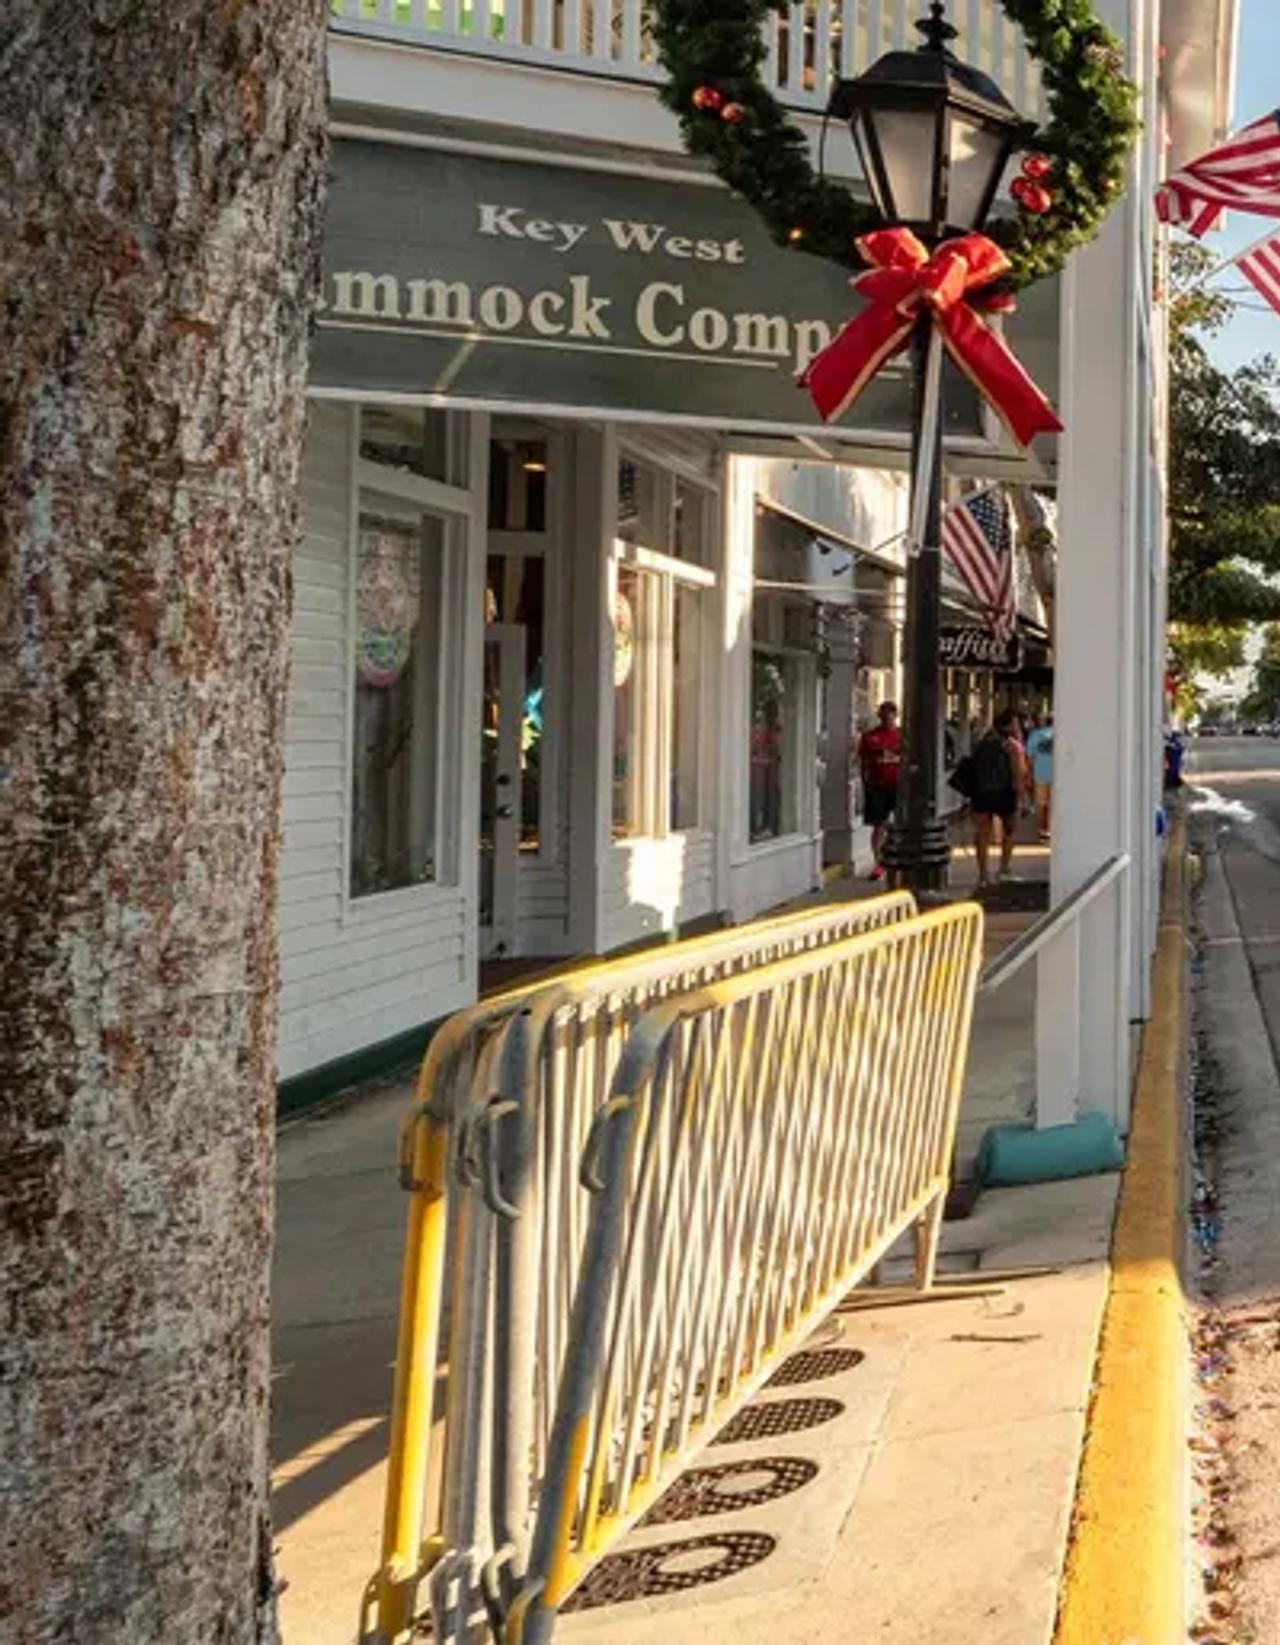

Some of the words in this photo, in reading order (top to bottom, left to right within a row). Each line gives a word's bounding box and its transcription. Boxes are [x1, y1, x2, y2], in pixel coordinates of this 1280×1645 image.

[478, 203, 588, 252] Key
[602, 217, 746, 264] West
[316, 272, 612, 339] mmock
[636, 281, 850, 377] Comp
